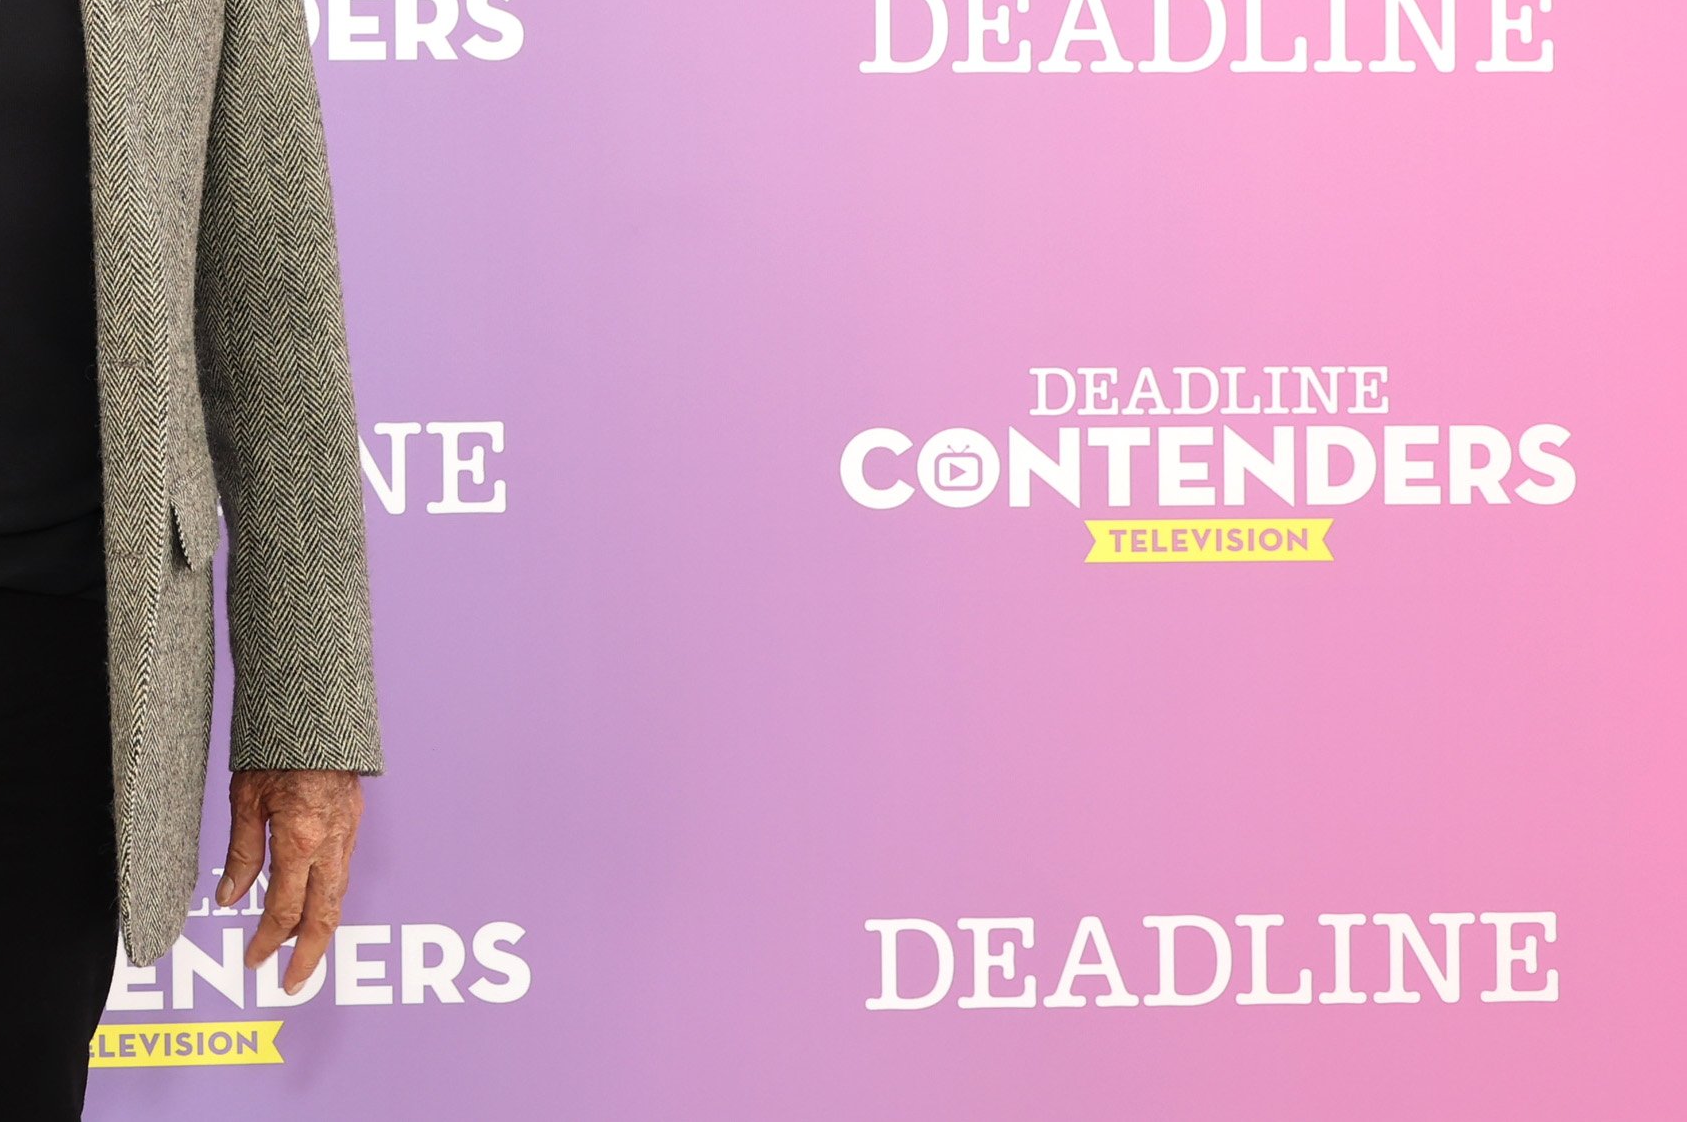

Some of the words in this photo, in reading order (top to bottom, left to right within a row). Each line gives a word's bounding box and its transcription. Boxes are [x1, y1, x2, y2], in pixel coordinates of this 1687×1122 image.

[1029, 366, 1389, 416] DEADLINE
[840, 423, 1576, 510] CONTENDERS
[1109, 527, 1310, 554] TELEVISION
[864, 911, 1559, 1011] DEADLINE
